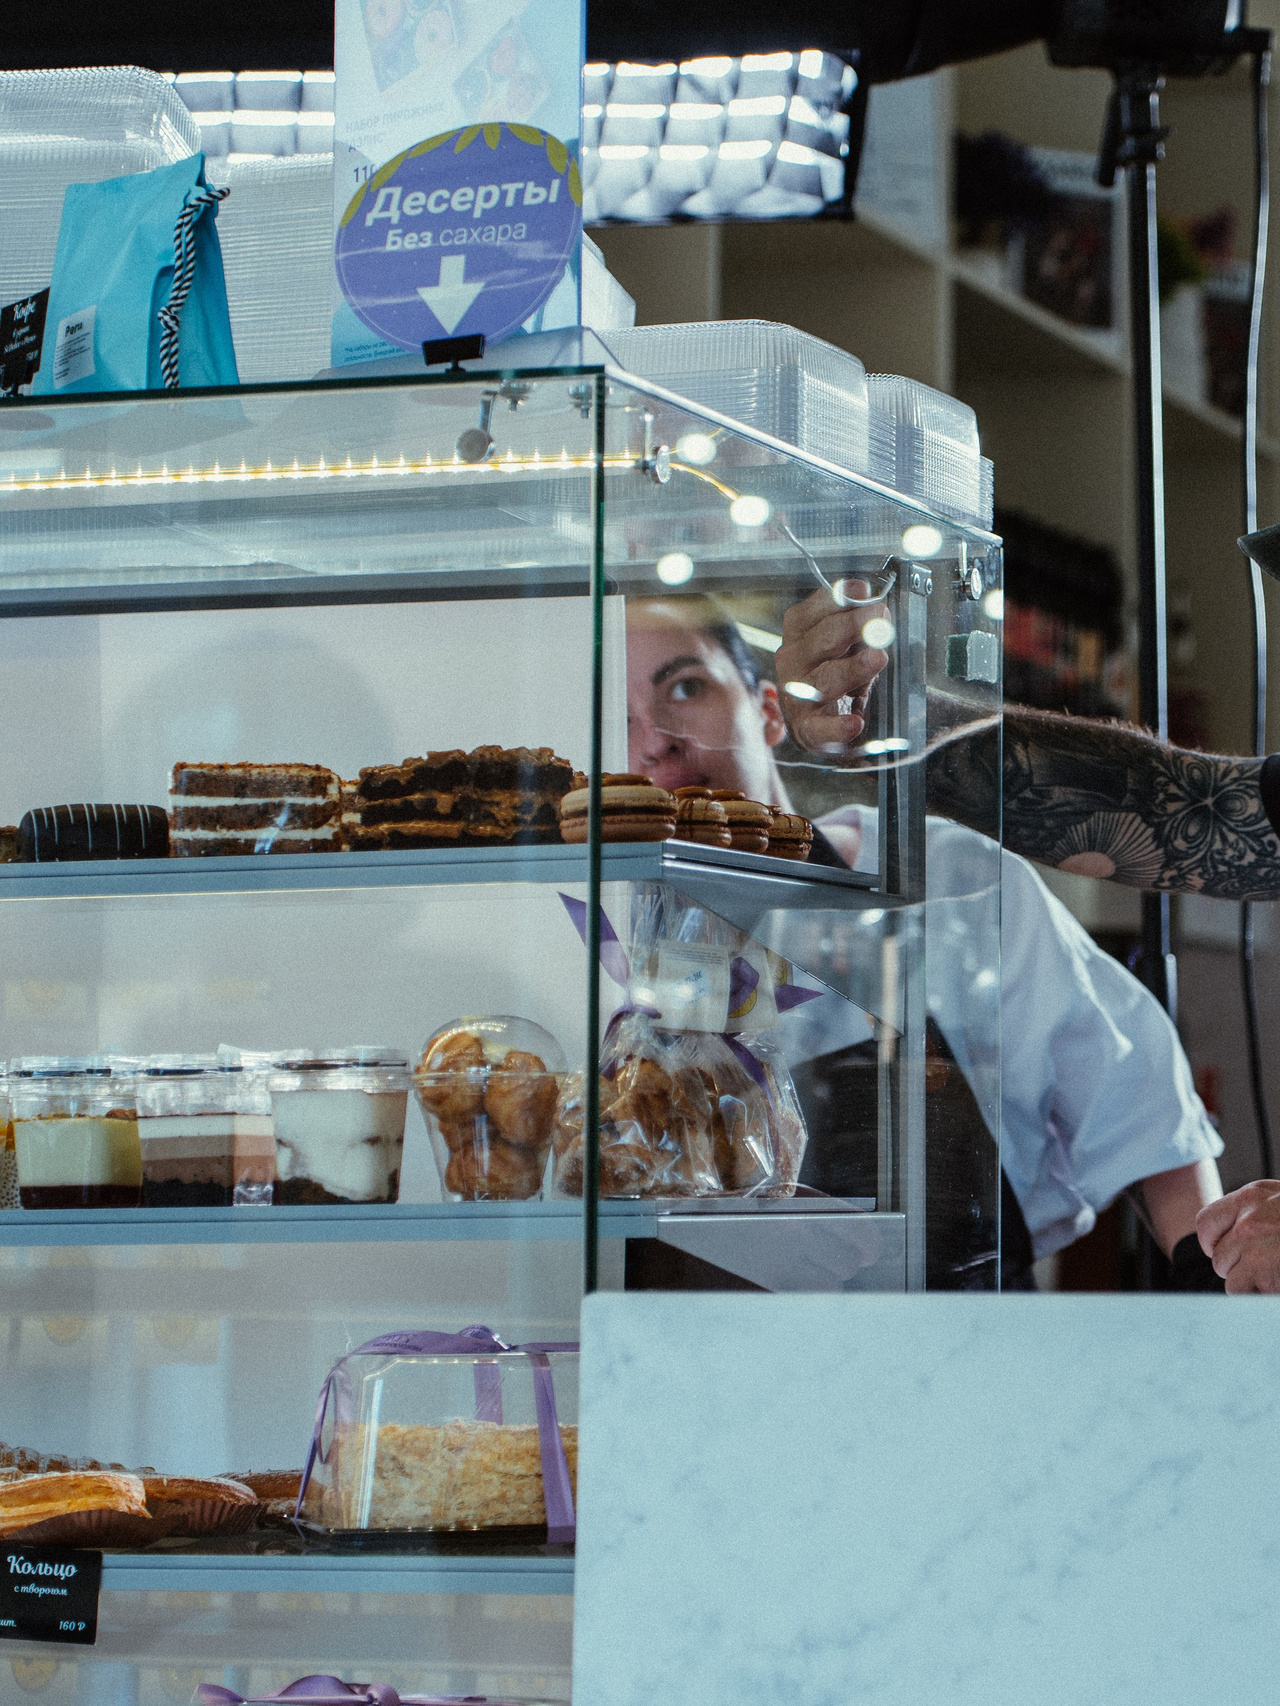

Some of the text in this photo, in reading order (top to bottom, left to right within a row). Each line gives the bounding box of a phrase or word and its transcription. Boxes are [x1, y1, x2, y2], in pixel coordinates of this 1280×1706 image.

[364, 179, 561, 227] Десерты
[385, 222, 528, 251] Без сахара
[65, 322, 83, 337] Peru
[7, 1555, 78, 1580] Кольцо
[20, 1583, 68, 1598] творогом
[59, 1621, 76, 1631] 160
